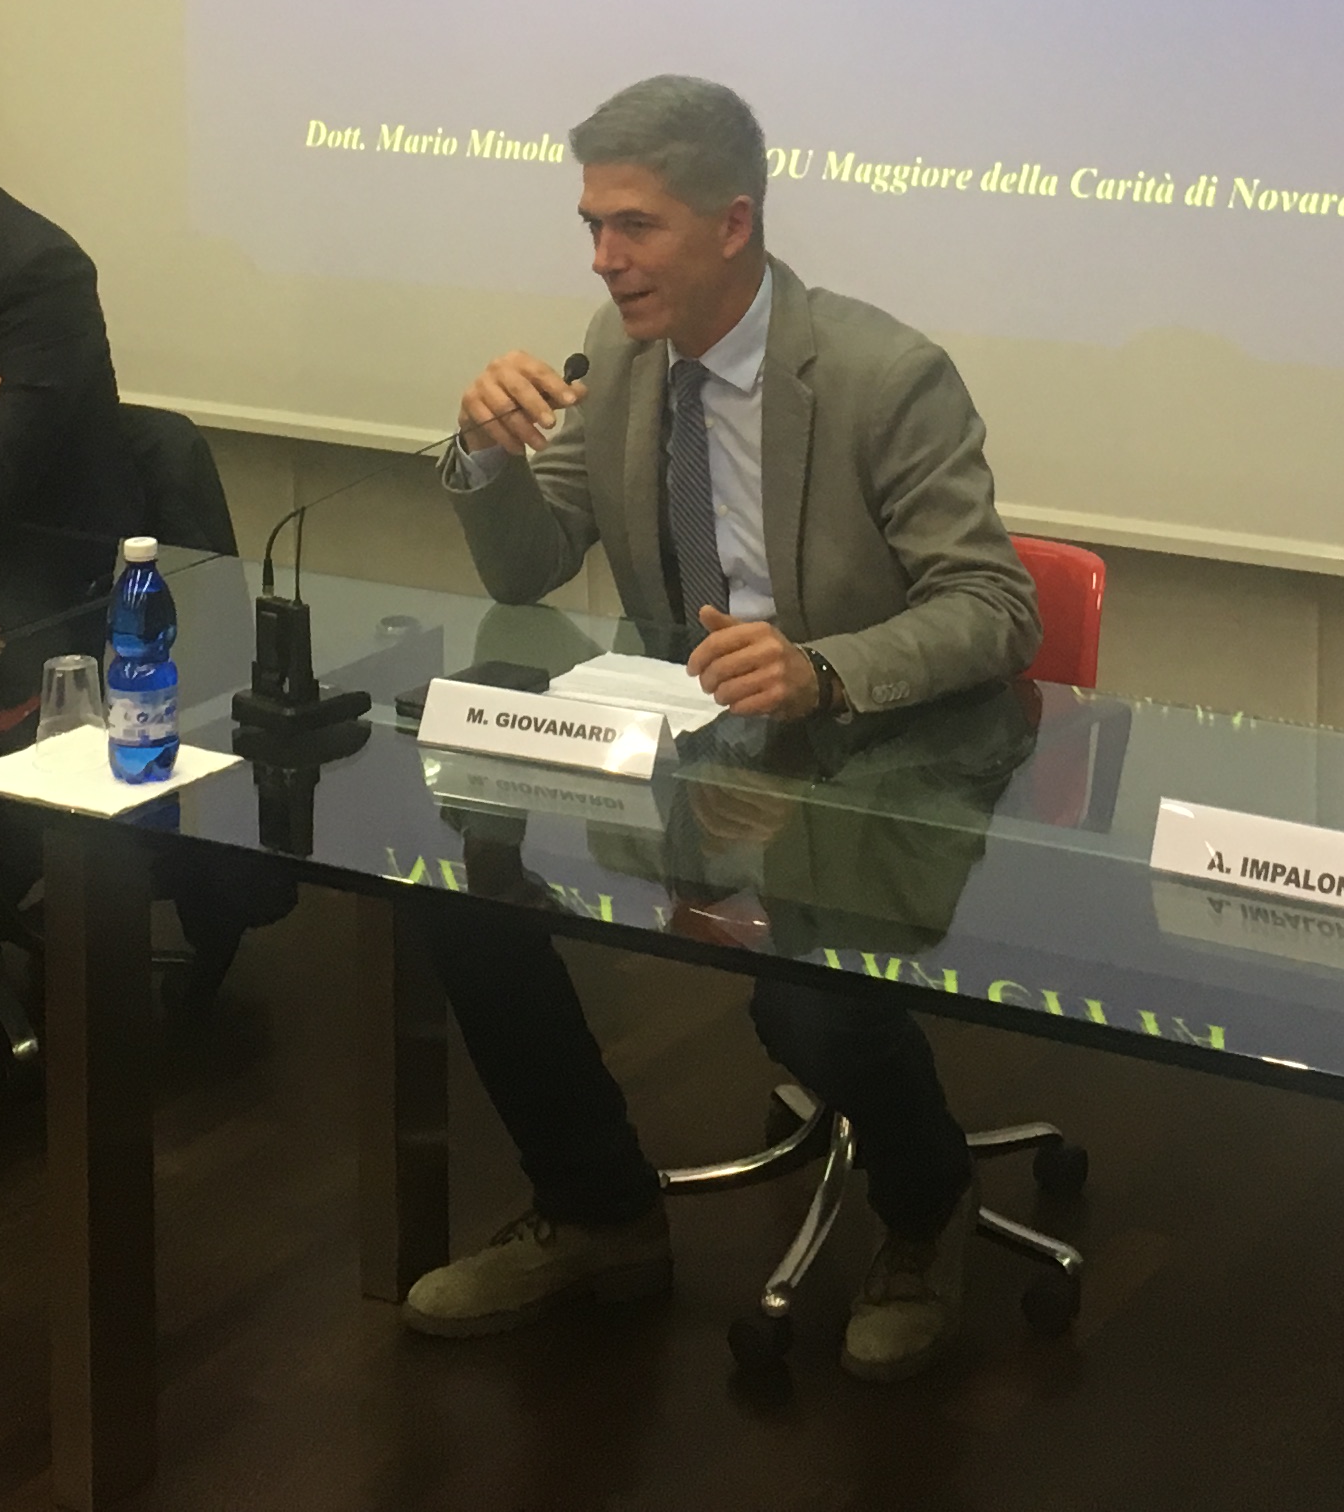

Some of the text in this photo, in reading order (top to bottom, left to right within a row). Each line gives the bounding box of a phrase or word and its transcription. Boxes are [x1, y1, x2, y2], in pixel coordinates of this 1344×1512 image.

[306, 119, 365, 151] Dott.
[376, 123, 458, 156] Mario
[466, 128, 565, 164] Minola
[822, 151, 974, 196] Maggiore
[979, 161, 1059, 197] della
[1069, 167, 1175, 205] Carità
[1184, 174, 1219, 208] di
[466, 707, 624, 744] M. GIOVANARD
[1207, 851, 1231, 874] A.
